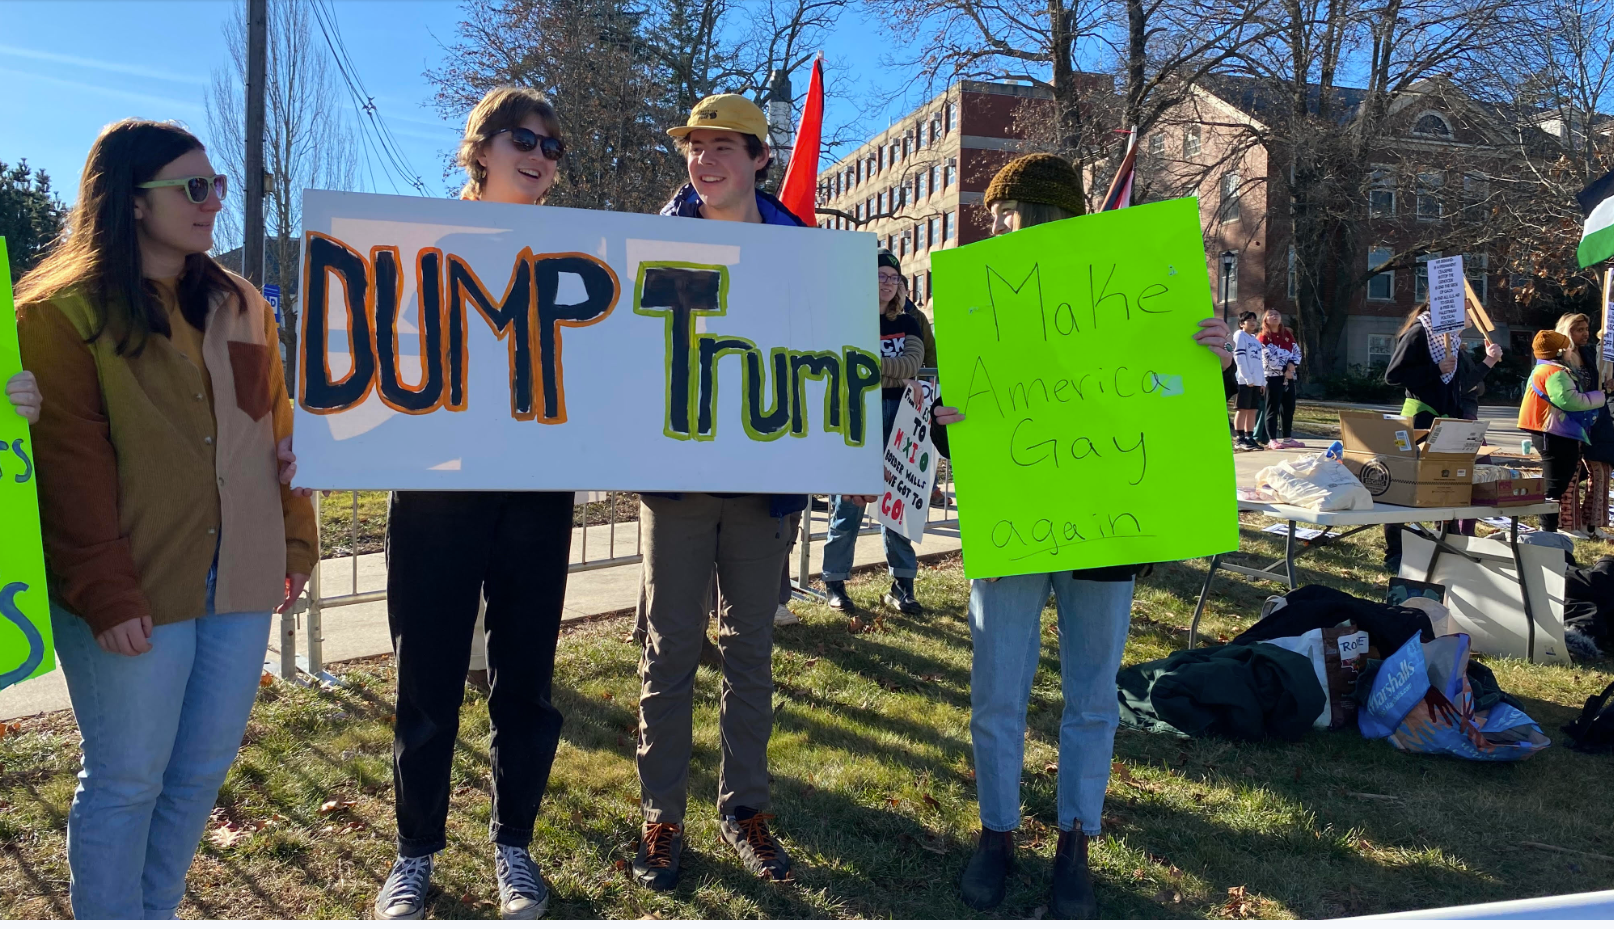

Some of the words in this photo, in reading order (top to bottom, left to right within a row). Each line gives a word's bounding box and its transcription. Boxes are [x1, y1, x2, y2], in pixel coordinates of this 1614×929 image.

[299, 231, 621, 424] DUMP
[965, 356, 1171, 418] America
[913, 417, 926, 442] TO
[1010, 418, 1146, 485] Gay
[885, 449, 904, 475] BORDER
[905, 469, 926, 489] WALLS
[882, 492, 905, 525] GO!
[897, 480, 911, 498] GOT
[912, 492, 923, 510] TO
[991, 512, 1141, 556] again
[1368, 659, 1414, 716] Marshalls
